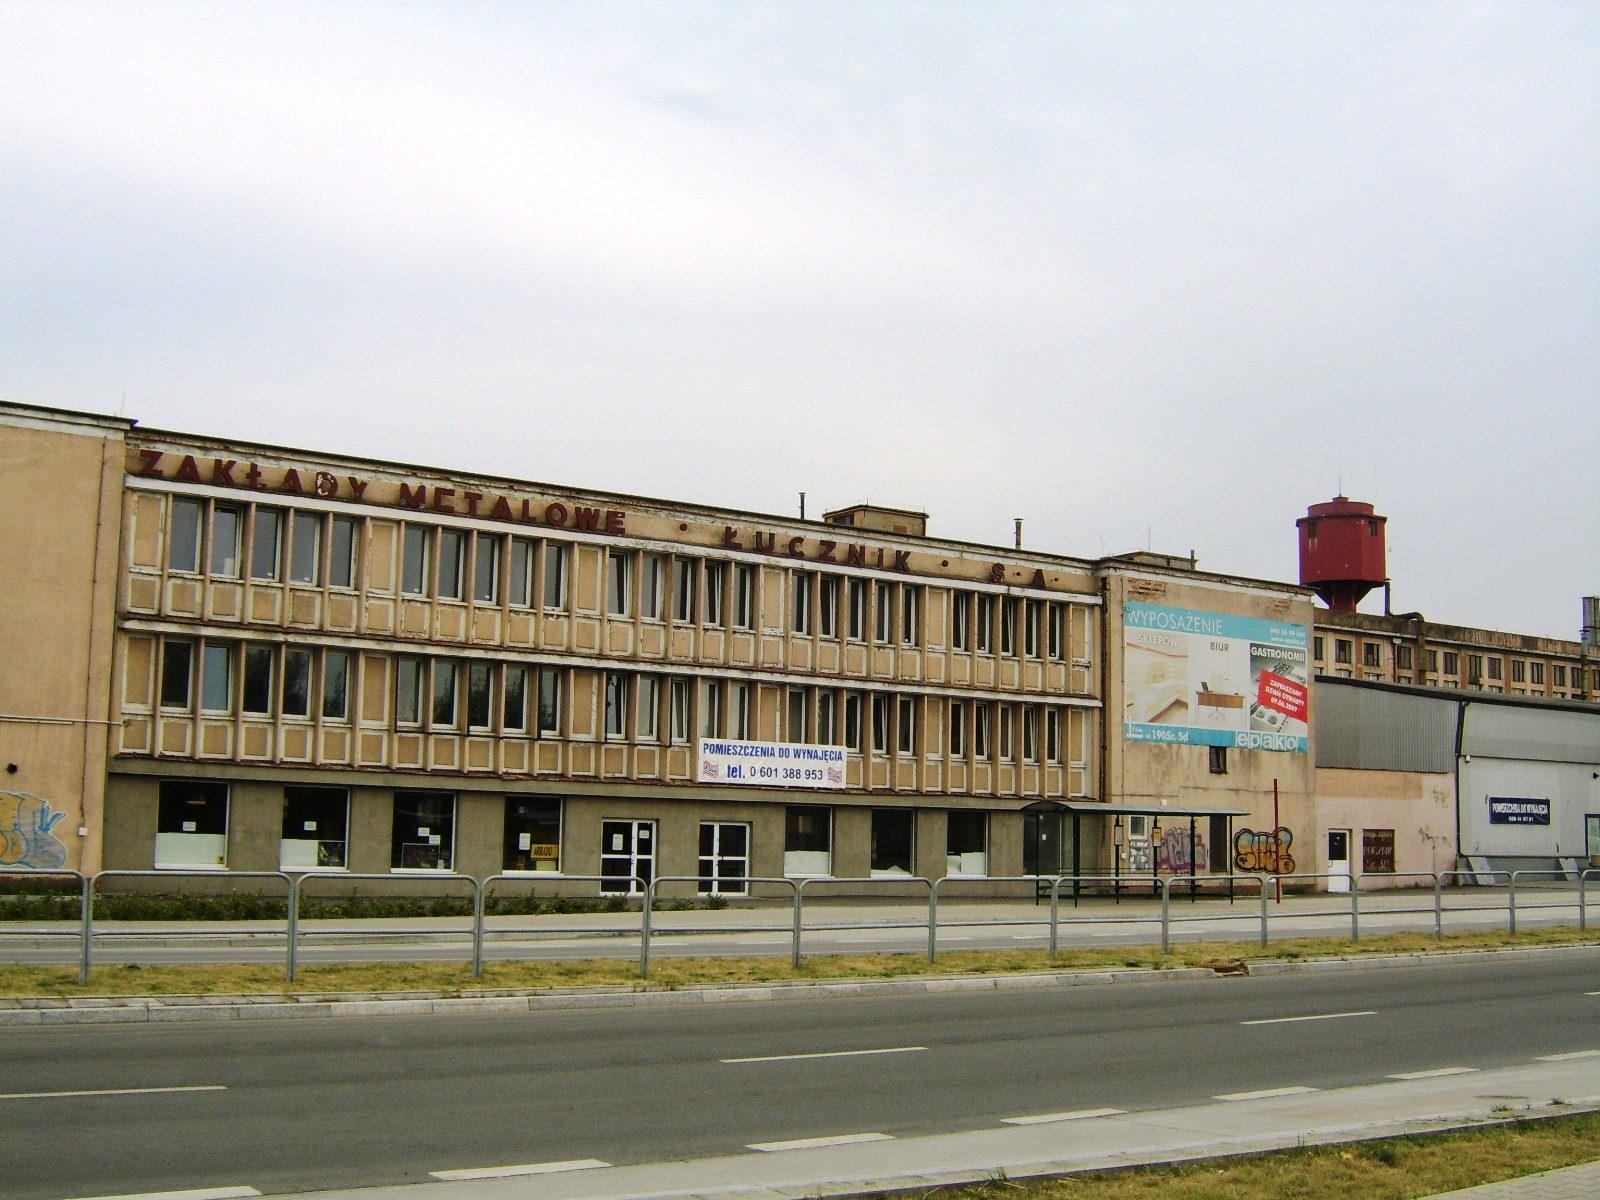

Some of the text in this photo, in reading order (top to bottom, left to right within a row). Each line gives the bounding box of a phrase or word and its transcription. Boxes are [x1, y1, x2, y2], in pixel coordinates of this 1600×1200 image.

[139, 449, 368, 501] ZAKŁADY
[400, 482, 626, 536] METALOWE
[724, 525, 911, 571] ŁUCZNIK
[1128, 609, 1222, 635] WYPOSAŻENIE
[1210, 641, 1230, 653] BIUR
[1251, 646, 1305, 662] GASTRONOMII
[1265, 686, 1305, 707] DZIEŃ OTWARTY
[1270, 679, 1303, 698] ZAPRASZAMY
[1178, 731, 1189, 741] 5d
[1237, 734, 1298, 750] epako
[703, 742, 843, 763] POMIESZCZENIA DO WYNAJĘCIA
[727, 764, 746, 779] tel.
[750, 766, 756, 777] 0
[760, 766, 778, 778] 601
[782, 768, 801, 779] 388
[804, 769, 823, 780] 953
